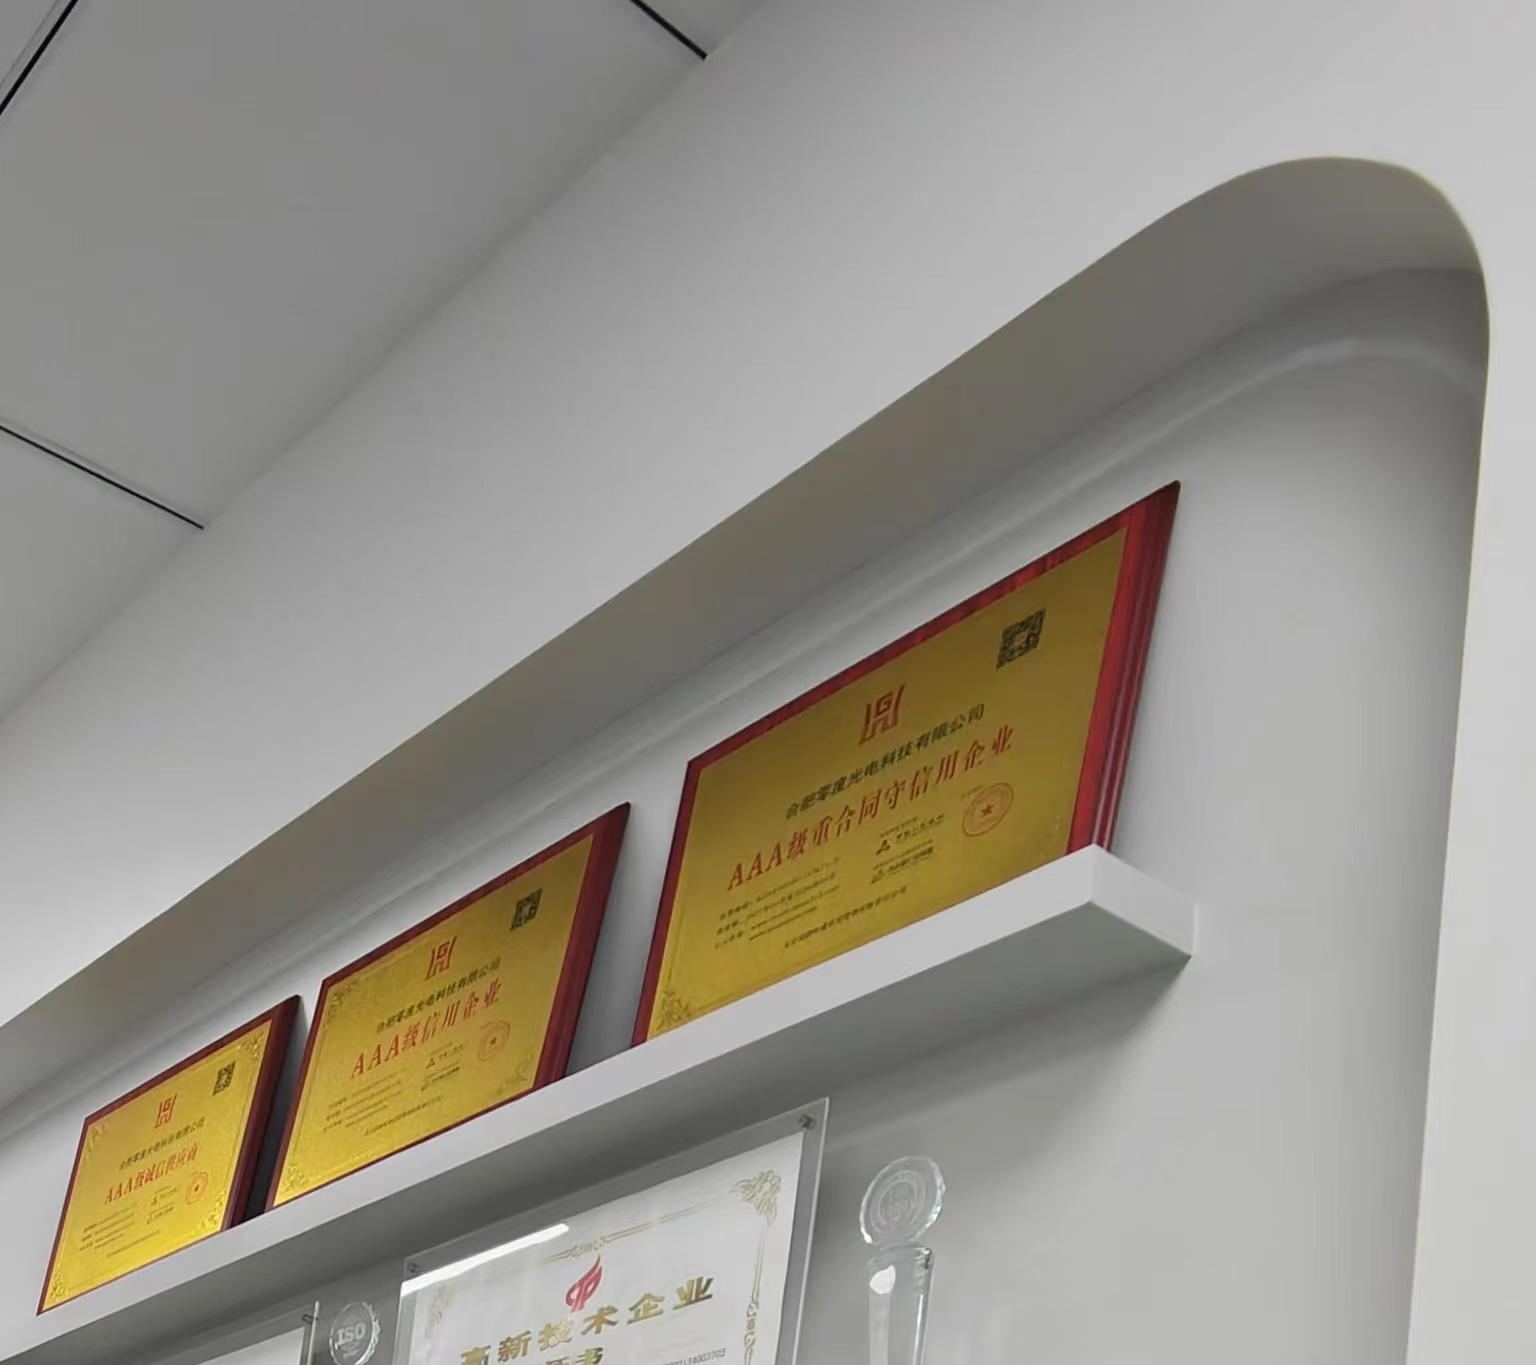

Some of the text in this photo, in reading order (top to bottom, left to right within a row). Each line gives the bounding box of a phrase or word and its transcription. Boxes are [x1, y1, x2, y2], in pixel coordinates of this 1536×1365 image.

[727, 724, 1014, 891] AAA级重合同守信用企业
[785, 704, 985, 820] 合肥零度光电科技有限公司
[351, 978, 502, 1079] AAA级信用企业
[337, 1322, 366, 1346] ISO
